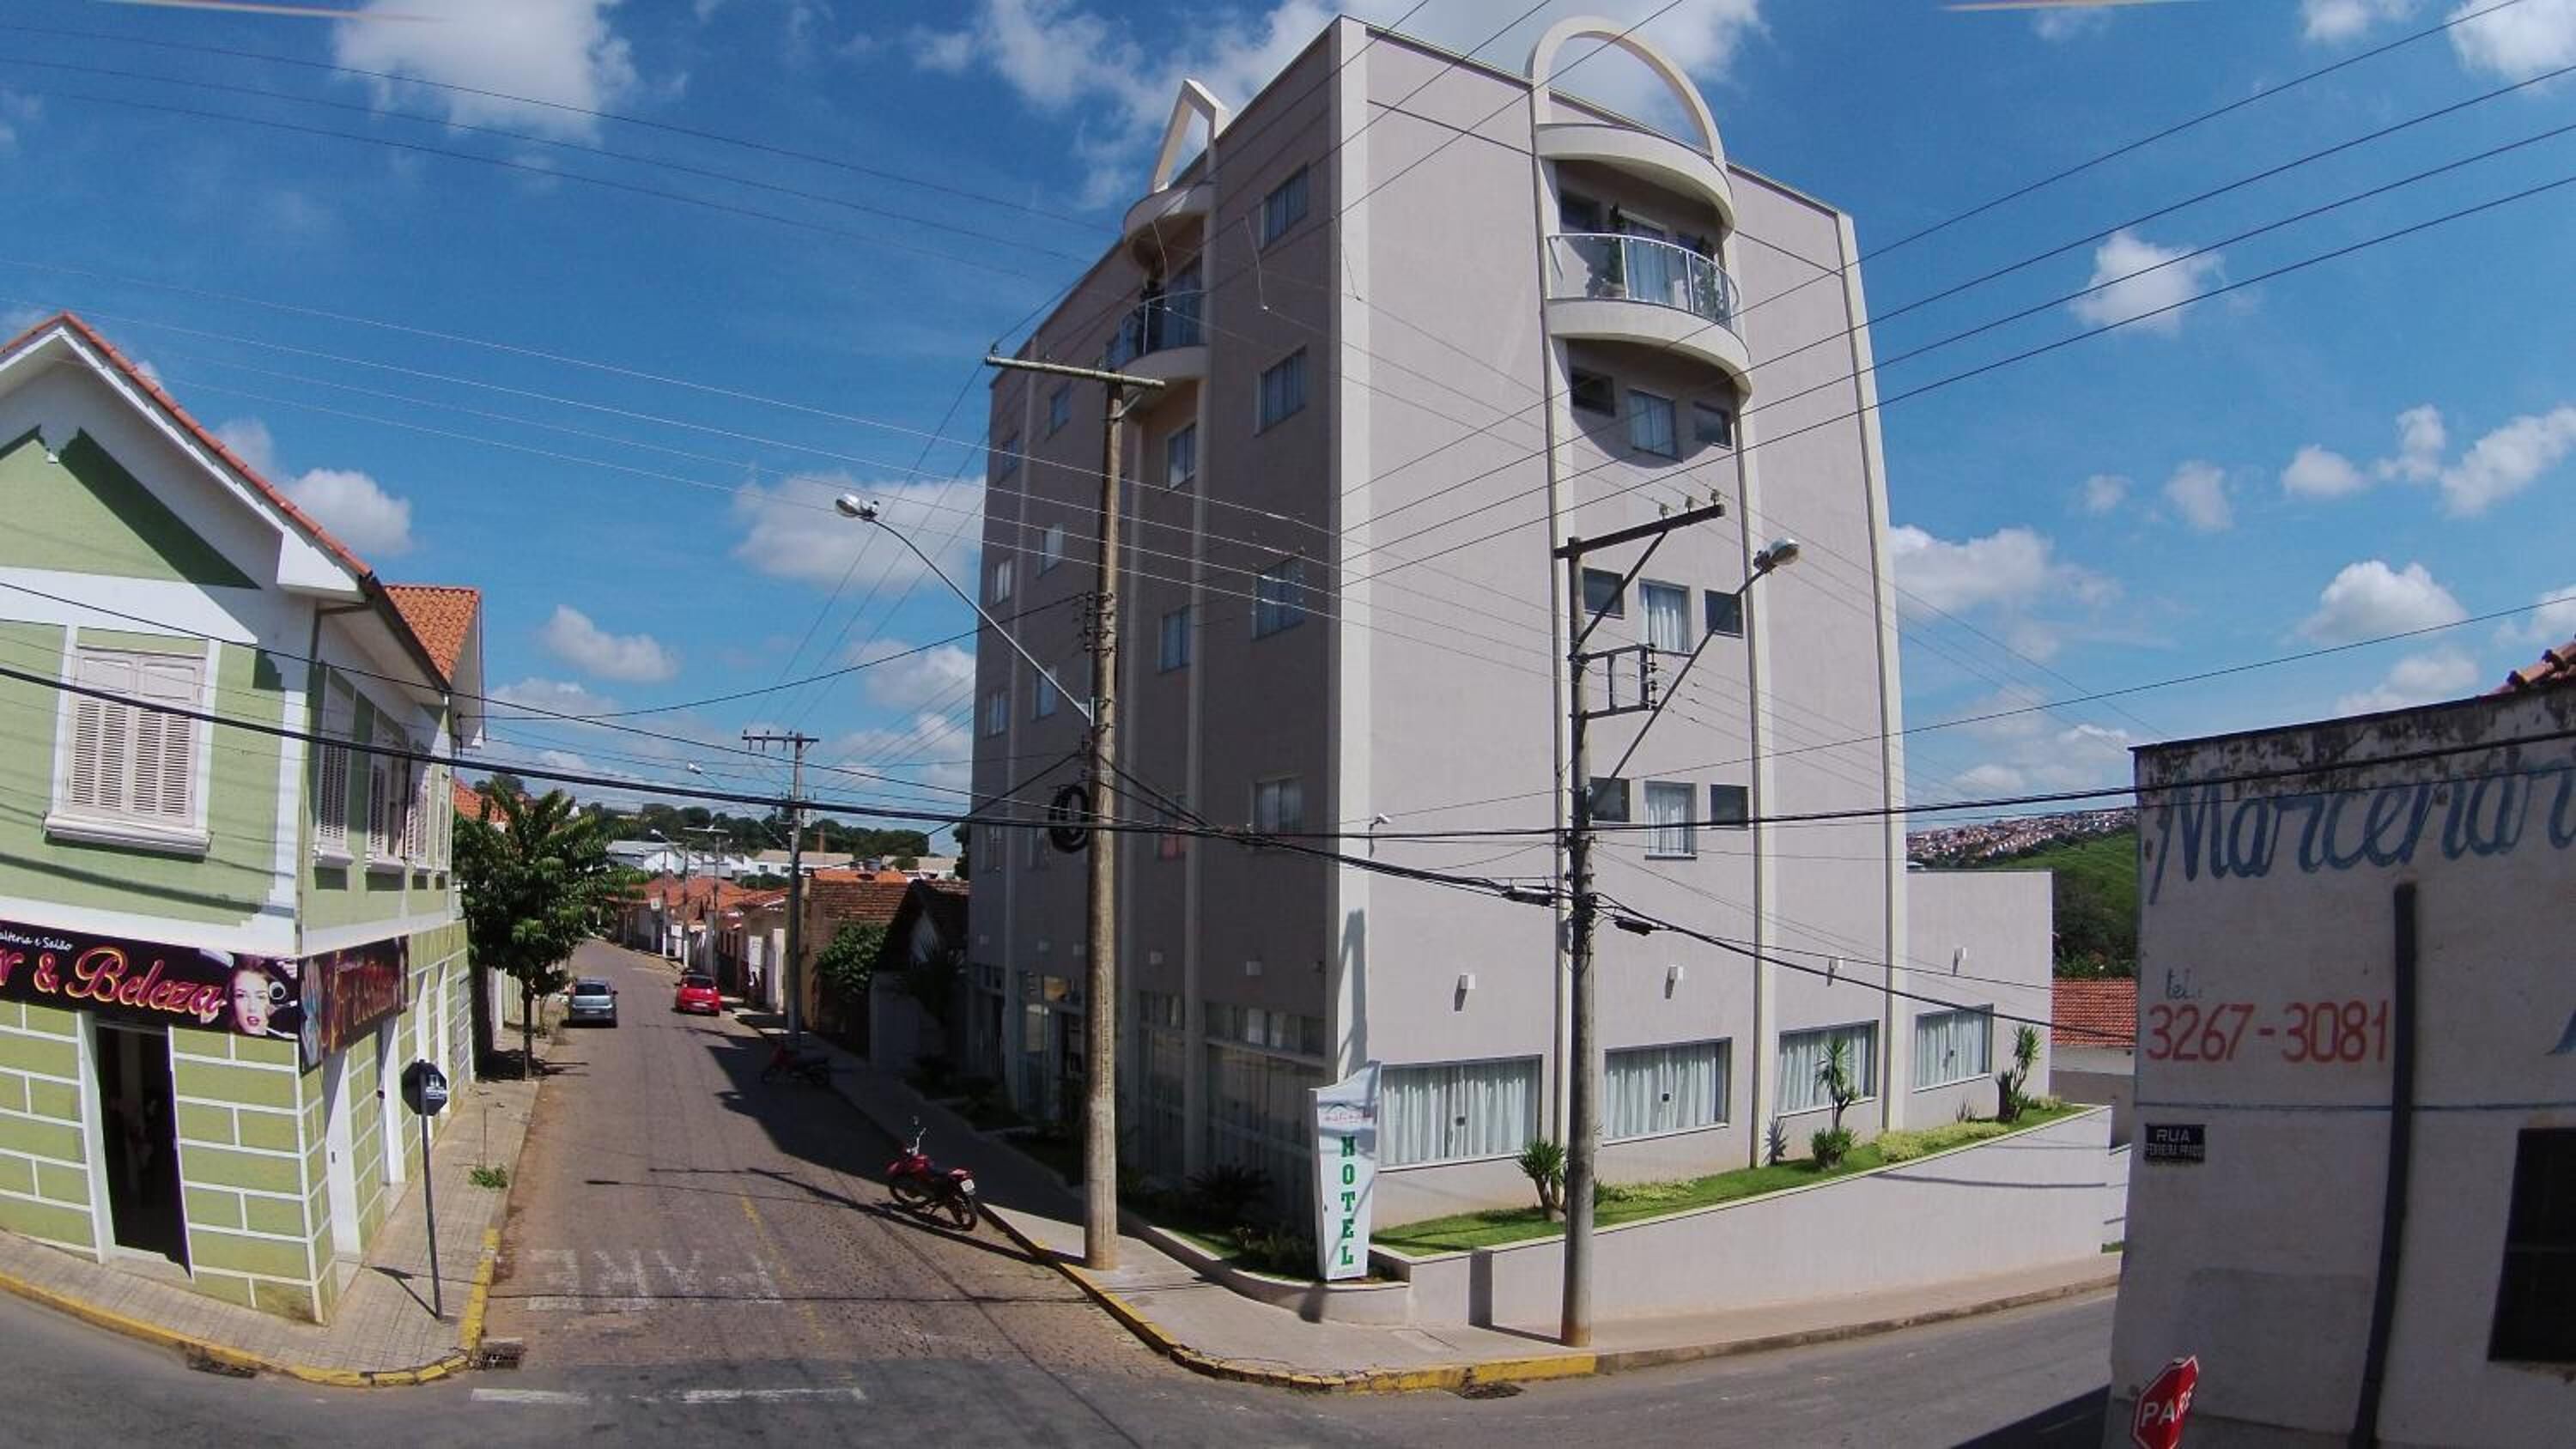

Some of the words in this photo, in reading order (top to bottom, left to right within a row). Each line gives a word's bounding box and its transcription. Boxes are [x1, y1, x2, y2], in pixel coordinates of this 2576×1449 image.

[34, 952, 59, 994] &
[65, 946, 228, 1016] Beleza
[2156, 1129, 2190, 1143] RUA
[1340, 1135, 1356, 1266] HOTEL
[2141, 1381, 2196, 1428] PARE
